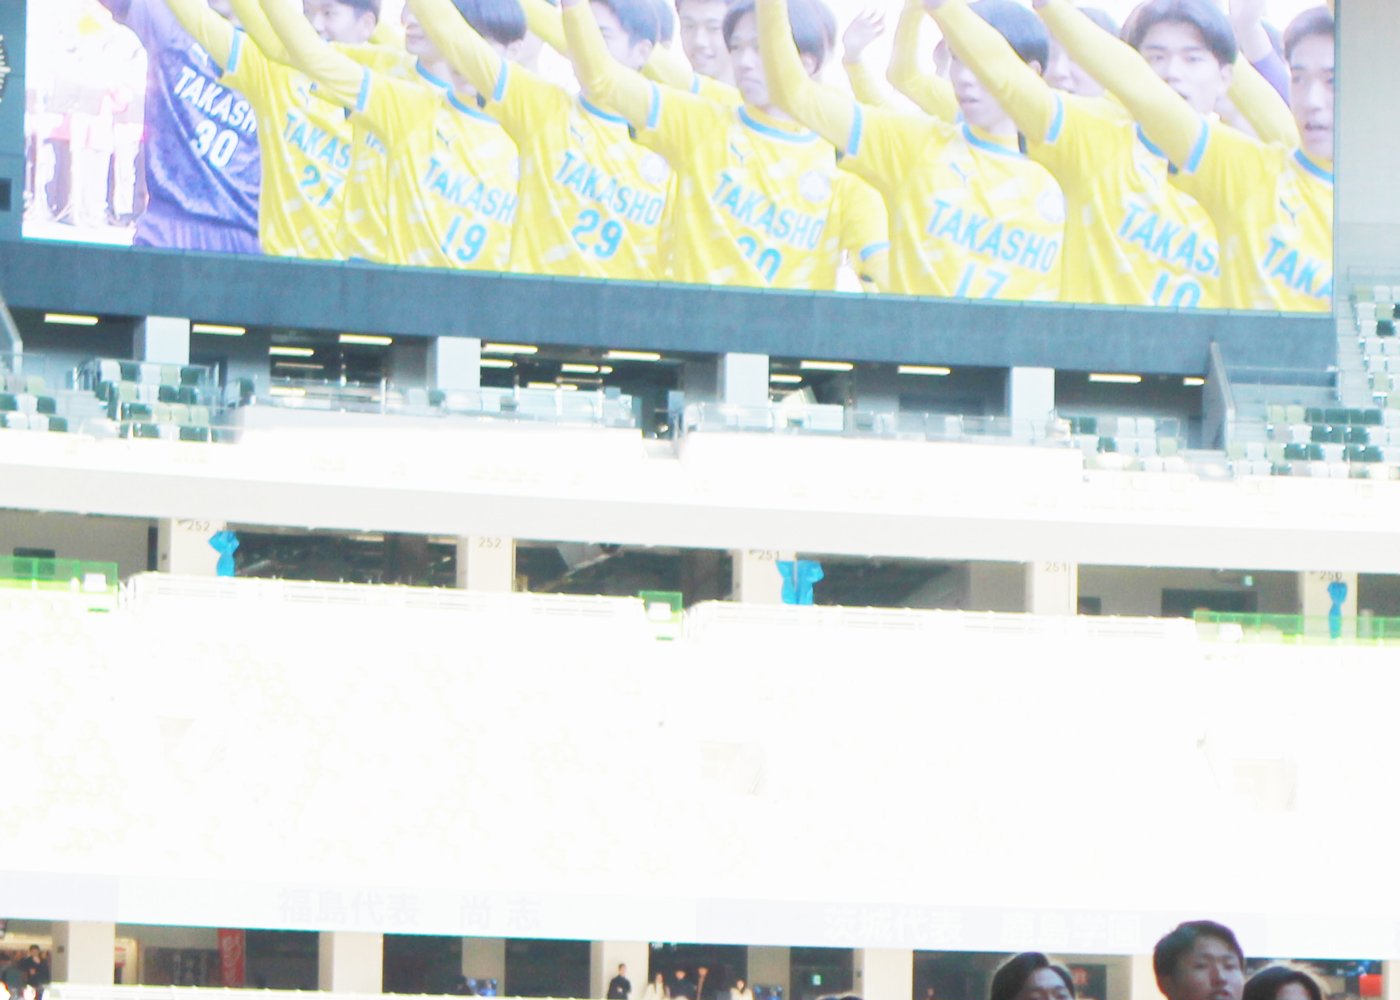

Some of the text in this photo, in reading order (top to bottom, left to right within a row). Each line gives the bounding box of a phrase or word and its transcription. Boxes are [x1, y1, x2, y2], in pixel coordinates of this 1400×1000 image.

[190, 119, 239, 168] 30
[300, 165, 346, 207] 27
[425, 157, 517, 223] TAKASH
[555, 150, 665, 226] TAKASHO
[571, 209, 624, 259] 29
[712, 172, 825, 251] TAKASHO
[927, 198, 1059, 273] TAKASHO
[441, 215, 487, 262] 19
[1118, 203, 1221, 277] TAKAS
[955, 262, 1009, 298] 17
[187, 520, 210, 533] 252
[478, 536, 502, 549] 252
[277, 887, 421, 928] 福島代表
[823, 906, 1144, 950] 茨城代表 鹿島学園
